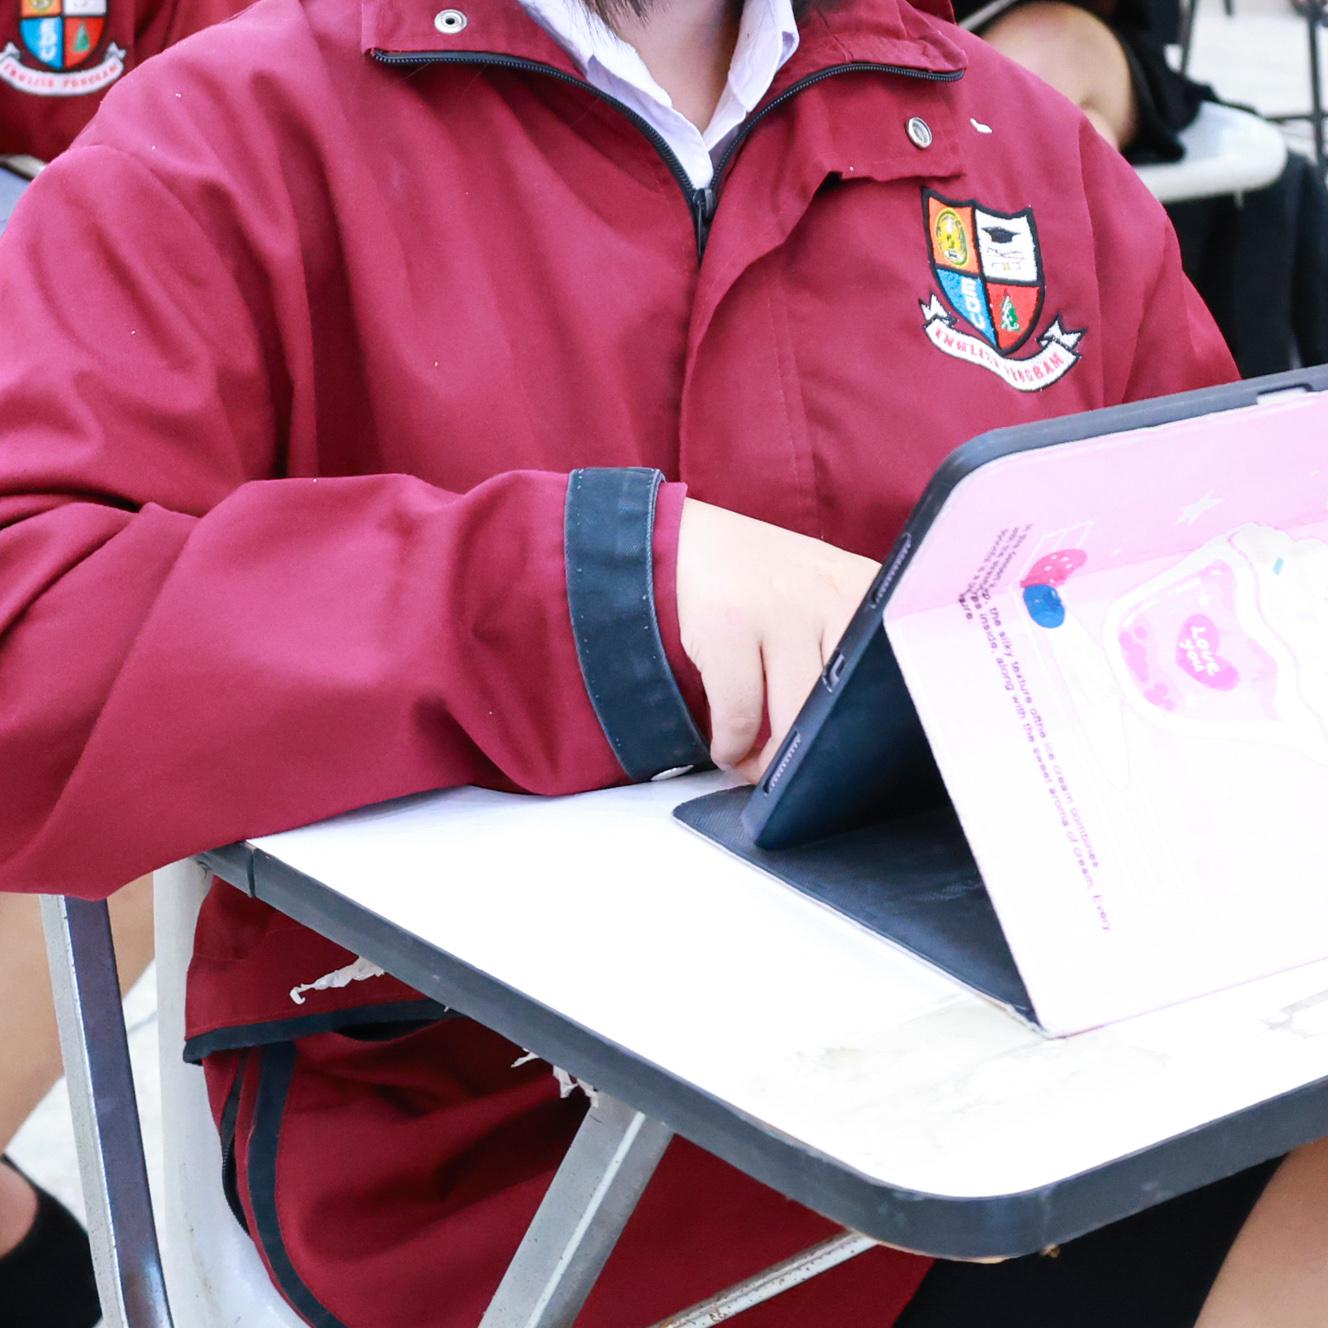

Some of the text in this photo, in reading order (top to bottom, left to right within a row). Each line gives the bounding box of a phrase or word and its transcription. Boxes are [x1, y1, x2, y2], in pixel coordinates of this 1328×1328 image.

[1178, 638, 1206, 673] you
[1191, 625, 1221, 677] Love
[1012, 660, 1033, 704] texture
